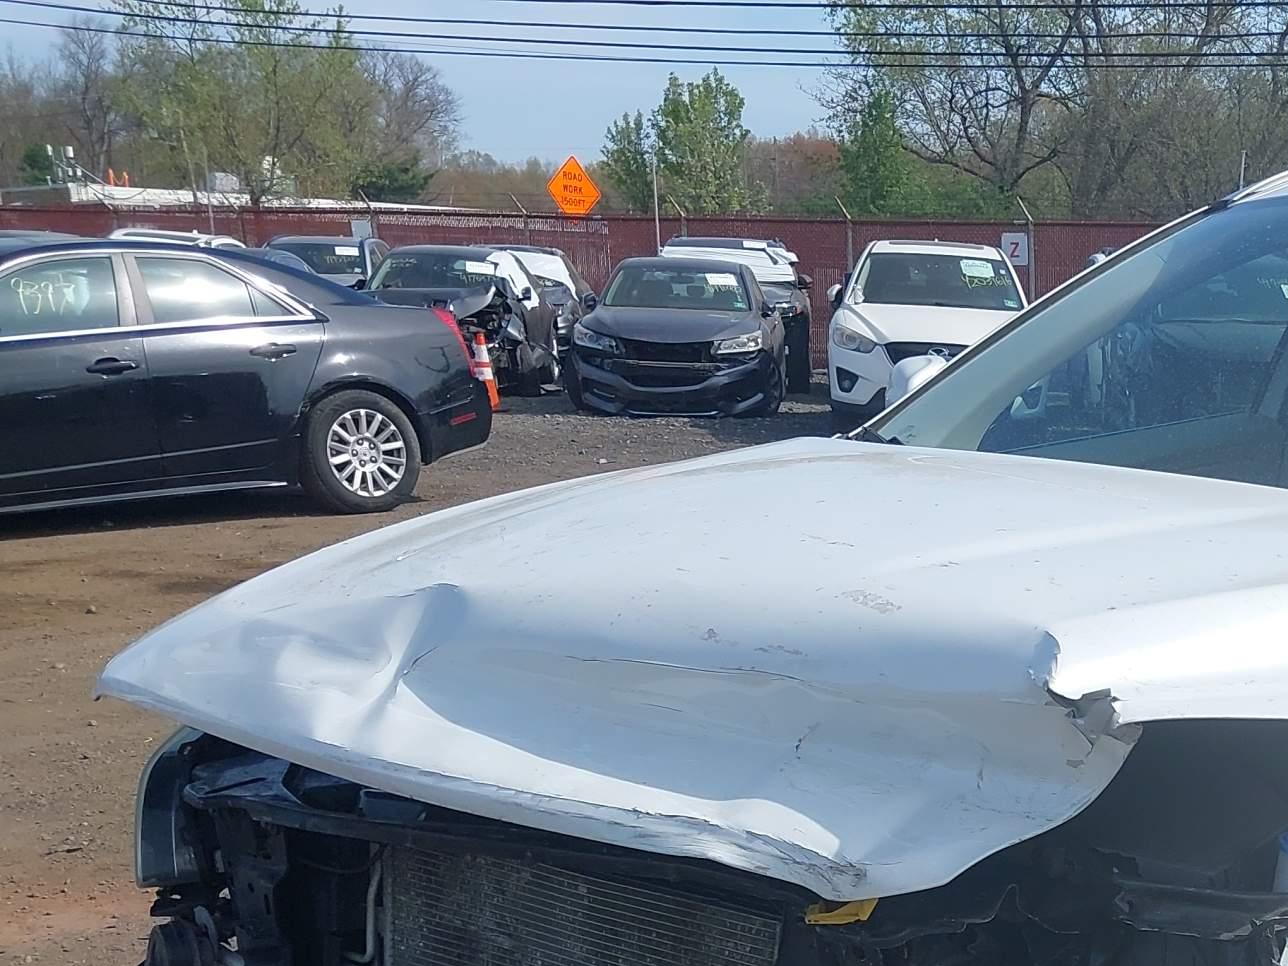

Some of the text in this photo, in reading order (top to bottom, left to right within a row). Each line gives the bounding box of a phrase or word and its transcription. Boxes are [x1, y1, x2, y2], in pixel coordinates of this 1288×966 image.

[562, 171, 583, 182] ROAD
[562, 184, 583, 195] WORK
[1010, 242, 1020, 258] Z
